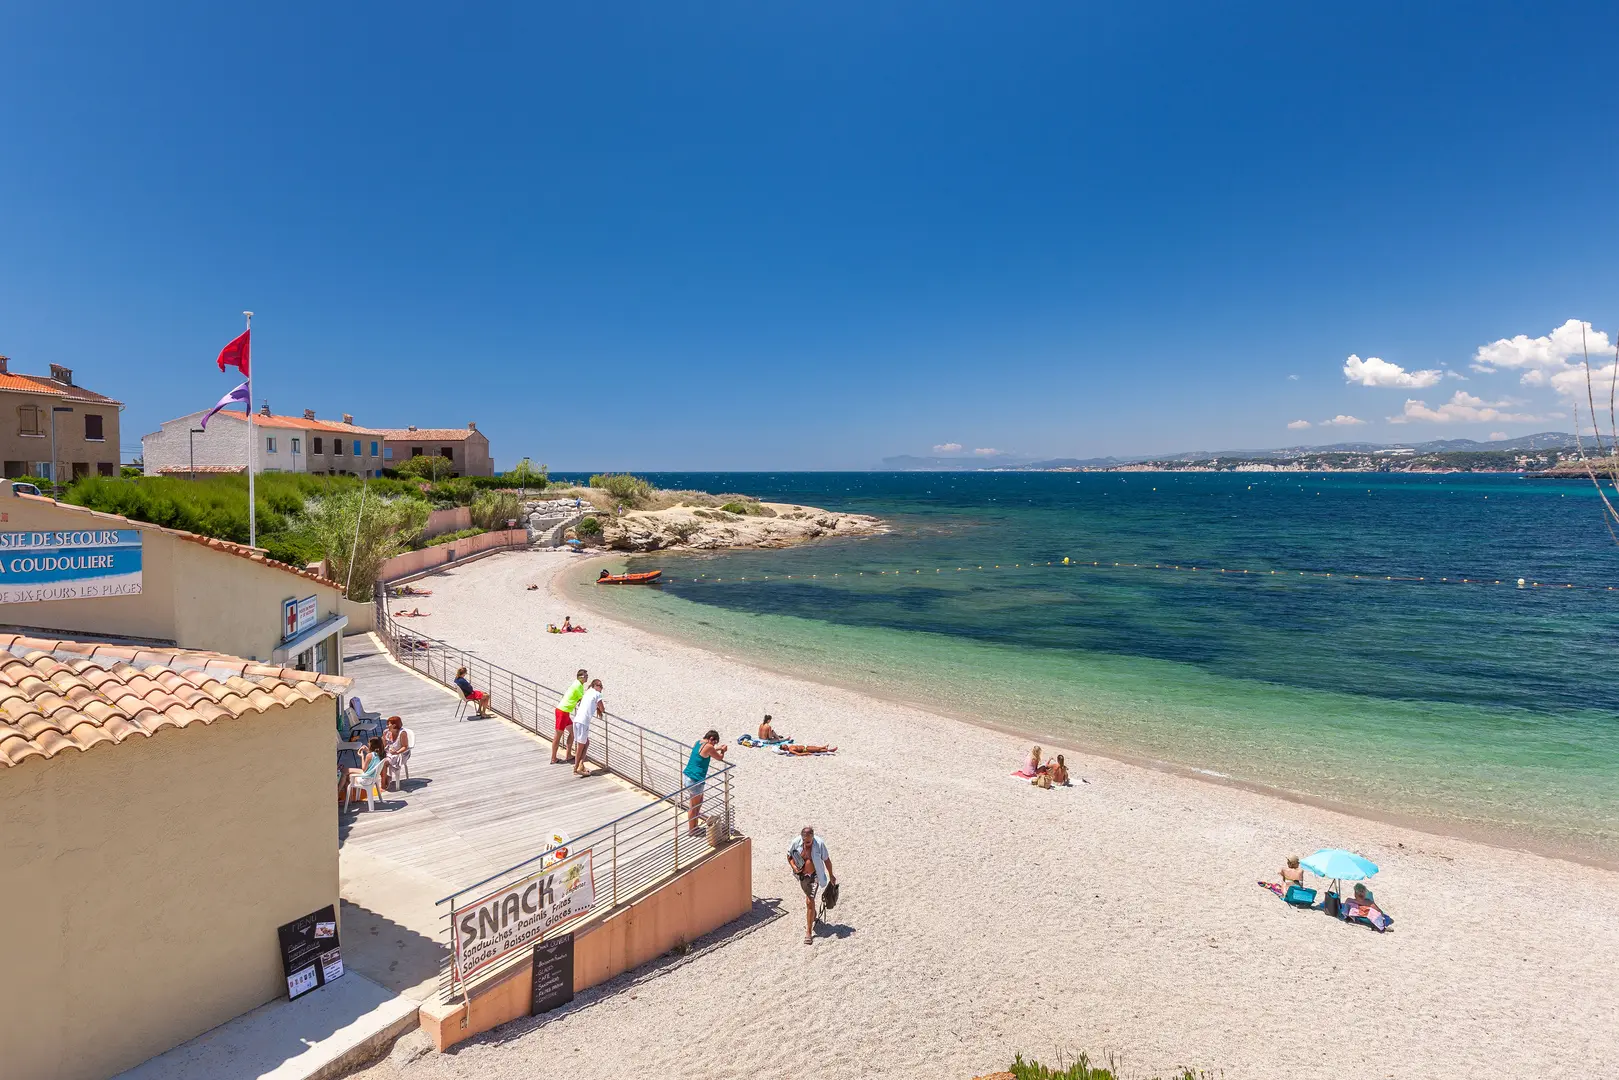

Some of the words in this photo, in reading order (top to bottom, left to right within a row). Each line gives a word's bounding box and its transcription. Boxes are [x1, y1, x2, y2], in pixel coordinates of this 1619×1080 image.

[32, 532, 52, 546] DE
[55, 530, 119, 546] SECOURS
[10, 554, 114, 573] COUDOULIERE
[81, 585, 98, 597] LES
[102, 583, 142, 596] PLAGES
[461, 874, 555, 949] SNACK
[463, 928, 513, 961] Sandwiches
[517, 910, 547, 930] Paninis
[552, 897, 571, 913] Frites
[463, 947, 497, 974] Salades
[504, 926, 540, 950] Boissons
[545, 908, 571, 927] Glaces
